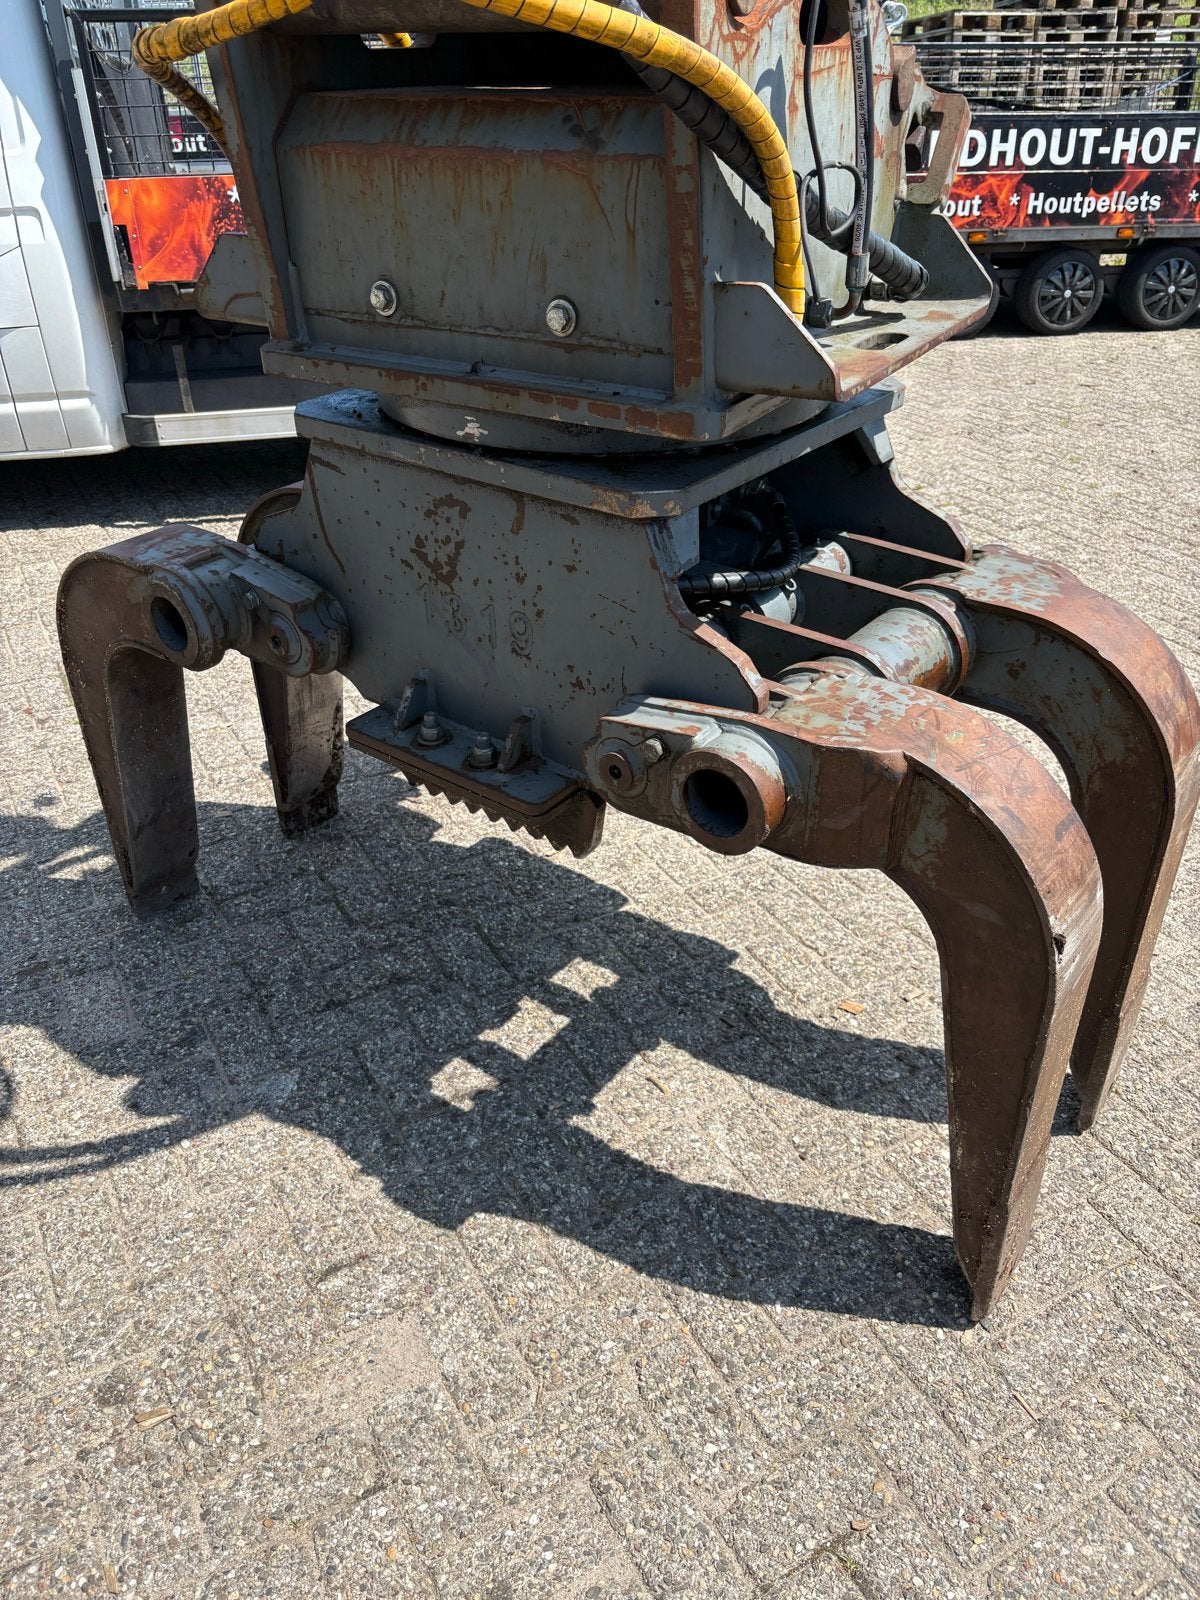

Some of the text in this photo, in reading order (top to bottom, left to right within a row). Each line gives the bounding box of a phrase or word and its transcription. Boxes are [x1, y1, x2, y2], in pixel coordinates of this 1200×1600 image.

[854, 39, 862, 53] WP
[928, 127, 1200, 168] DHOUT-HOF
[1027, 190, 1162, 218] Houtpellets
